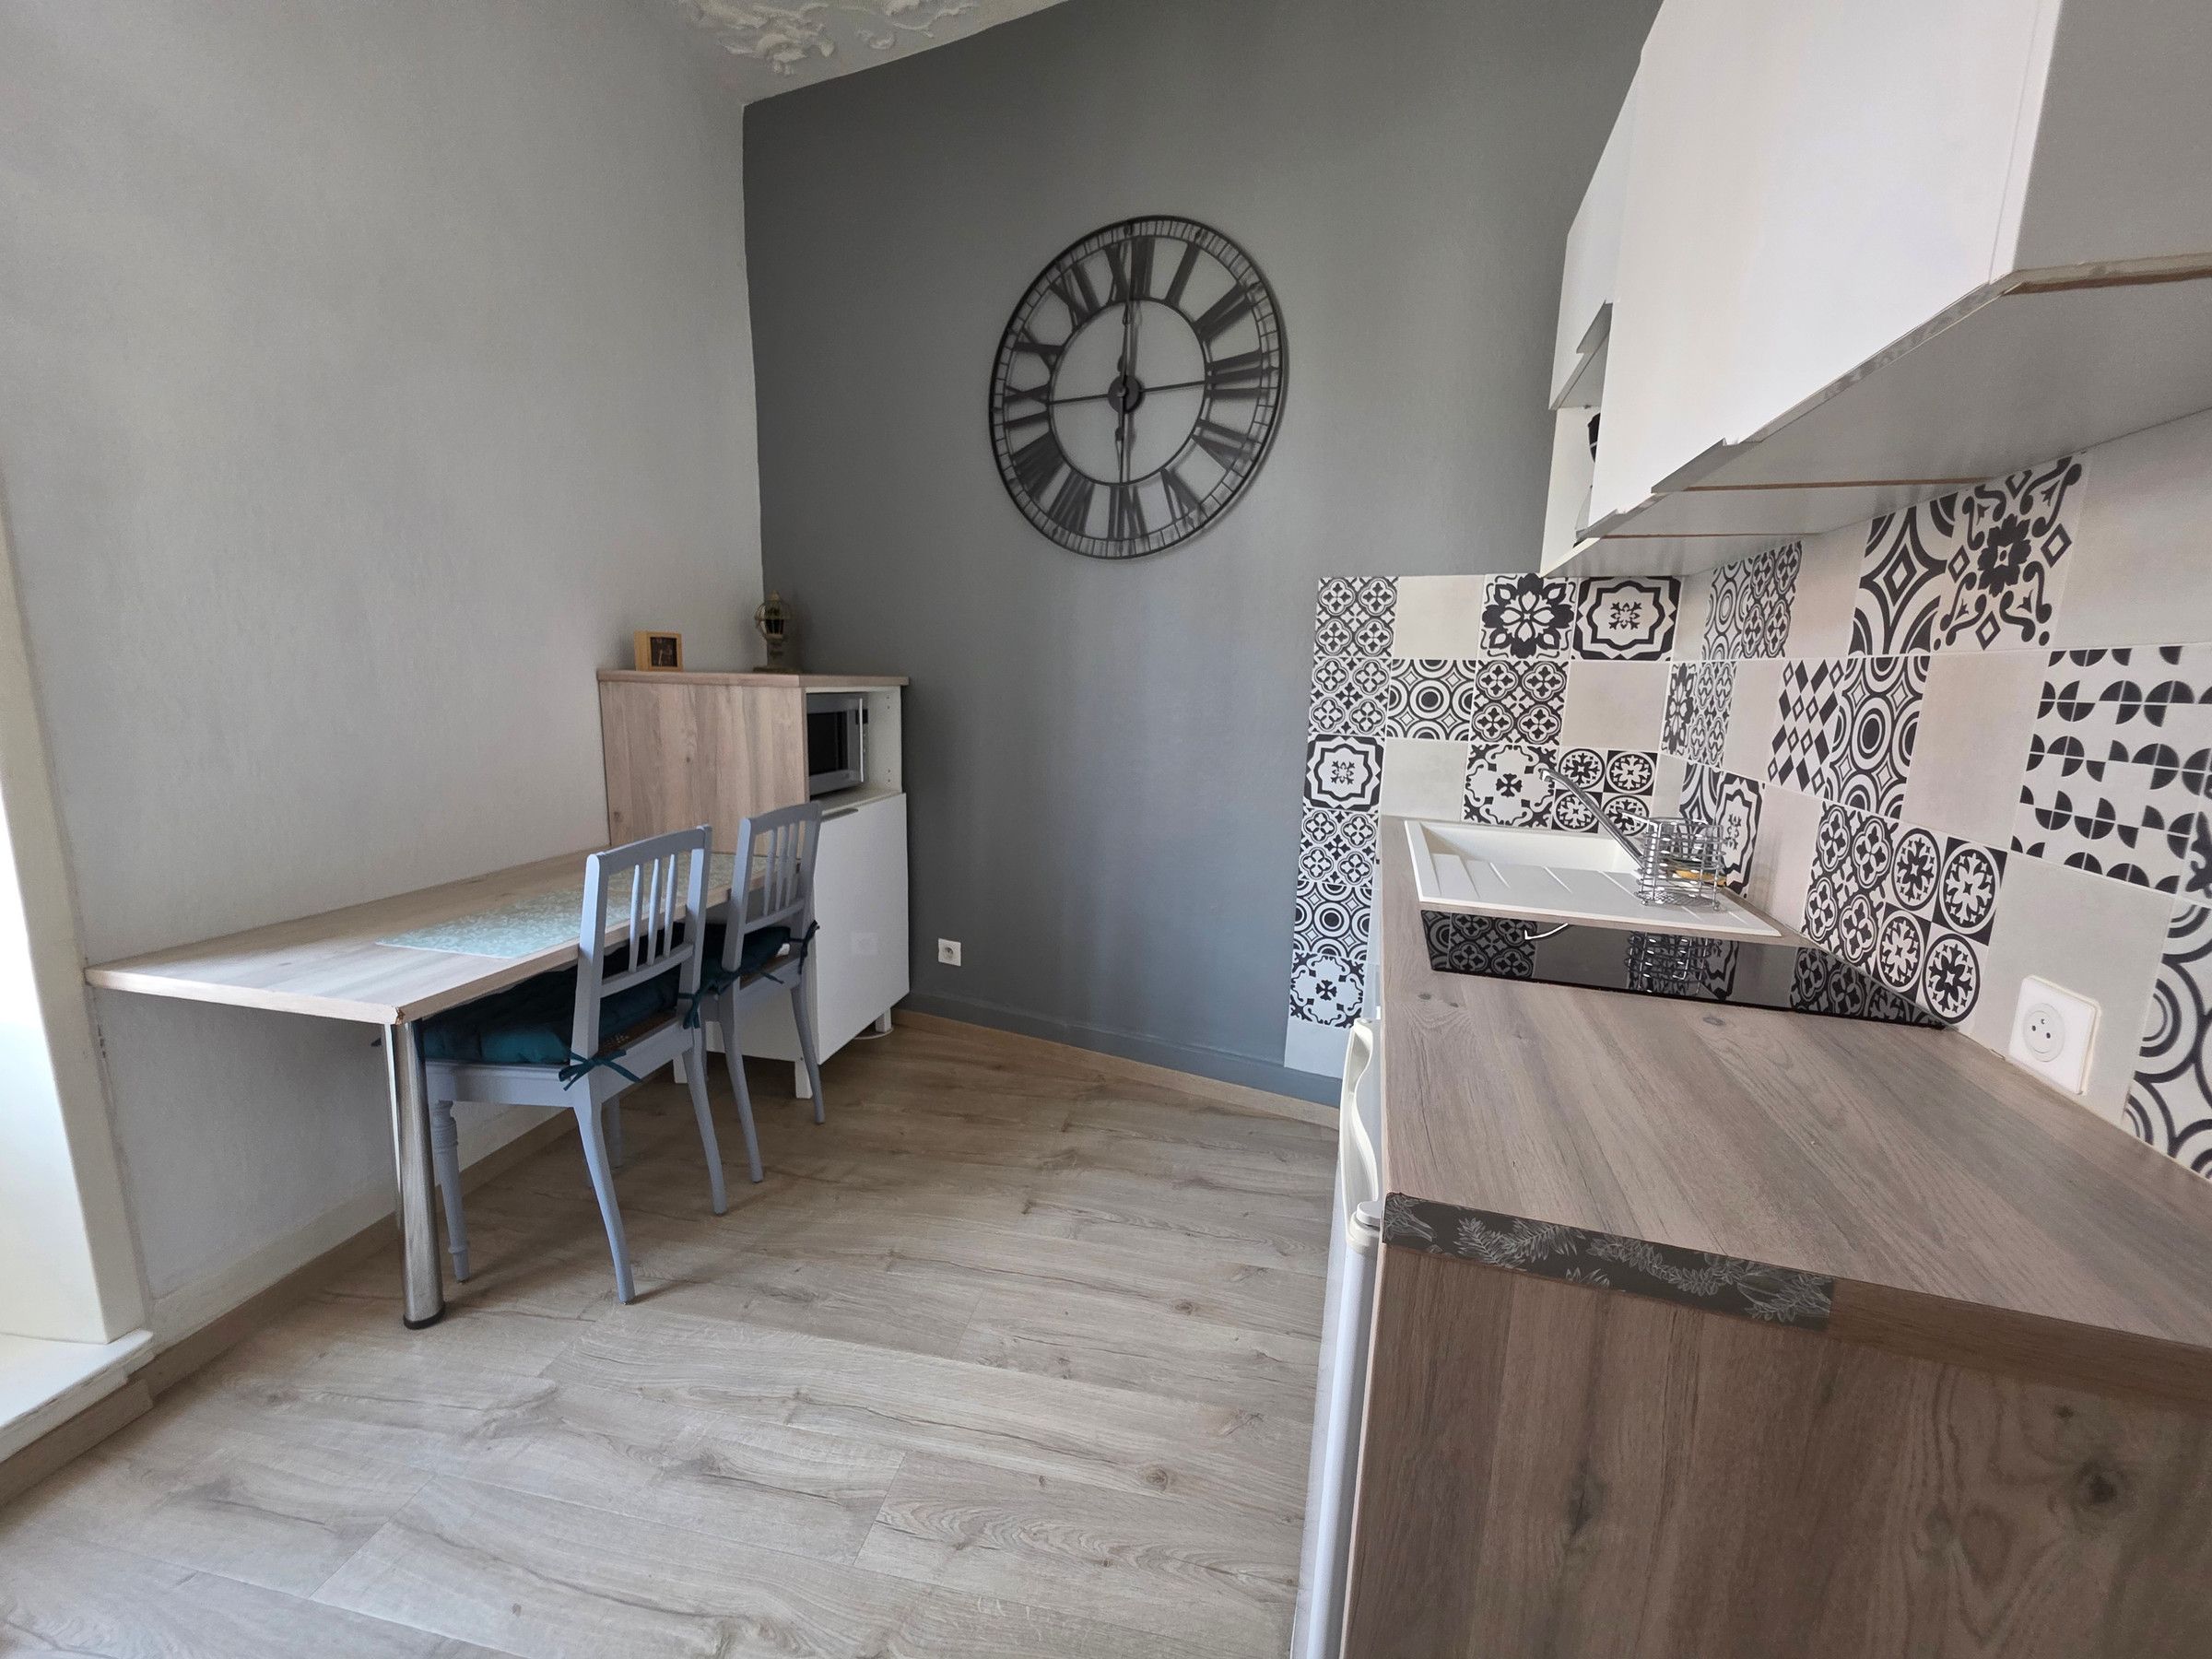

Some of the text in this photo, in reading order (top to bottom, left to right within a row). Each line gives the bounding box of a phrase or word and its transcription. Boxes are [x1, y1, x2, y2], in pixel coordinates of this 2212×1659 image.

[1049, 265, 1101, 329] XI
[1165, 241, 1201, 308] I
[1194, 282, 1254, 342] II
[1206, 349, 1263, 399] III
